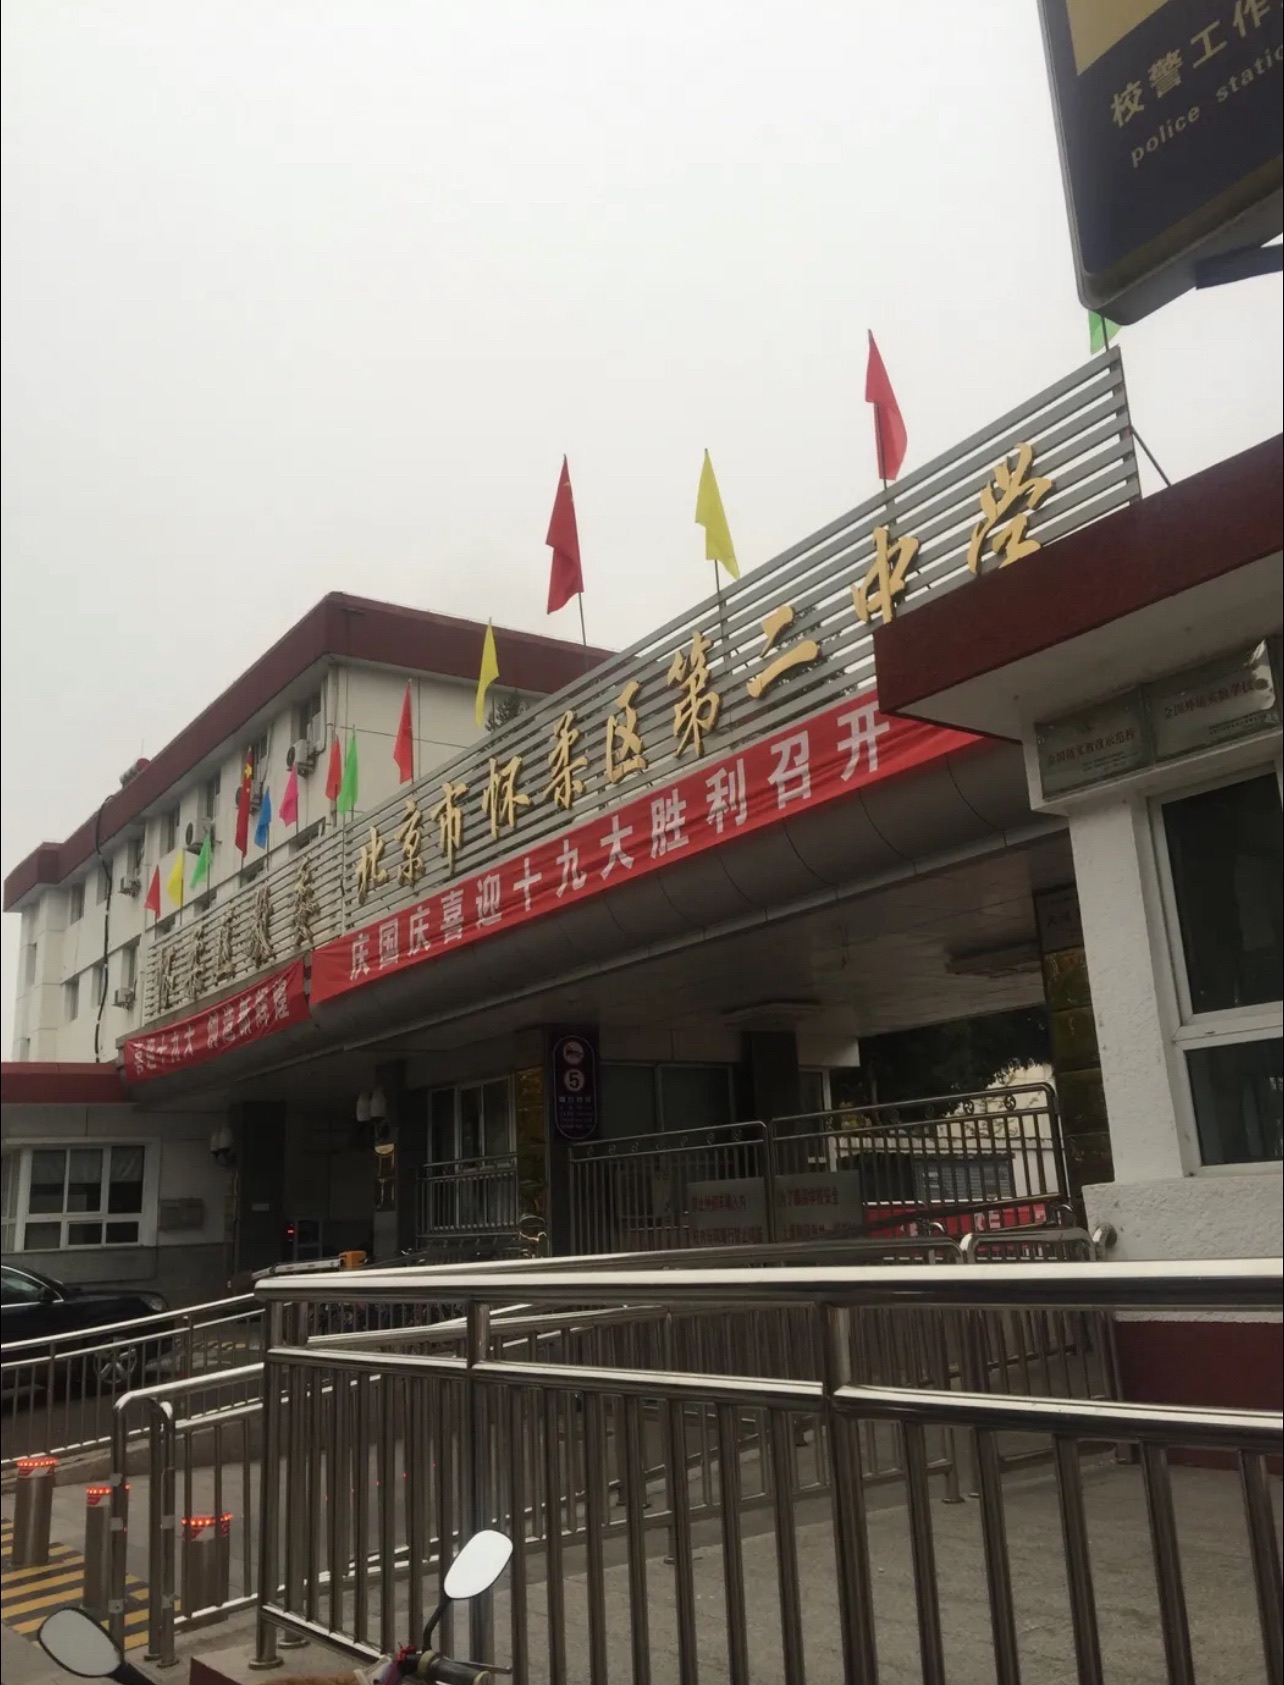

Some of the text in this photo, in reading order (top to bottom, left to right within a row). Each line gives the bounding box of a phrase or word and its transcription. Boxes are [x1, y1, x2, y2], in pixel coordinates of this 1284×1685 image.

[1111, 0, 1283, 127] 校警工作
[1131, 105, 1200, 168] police
[348, 704, 891, 981] 庆国庆喜迎十九大胜利召开
[569, 1072, 579, 1088] 5
